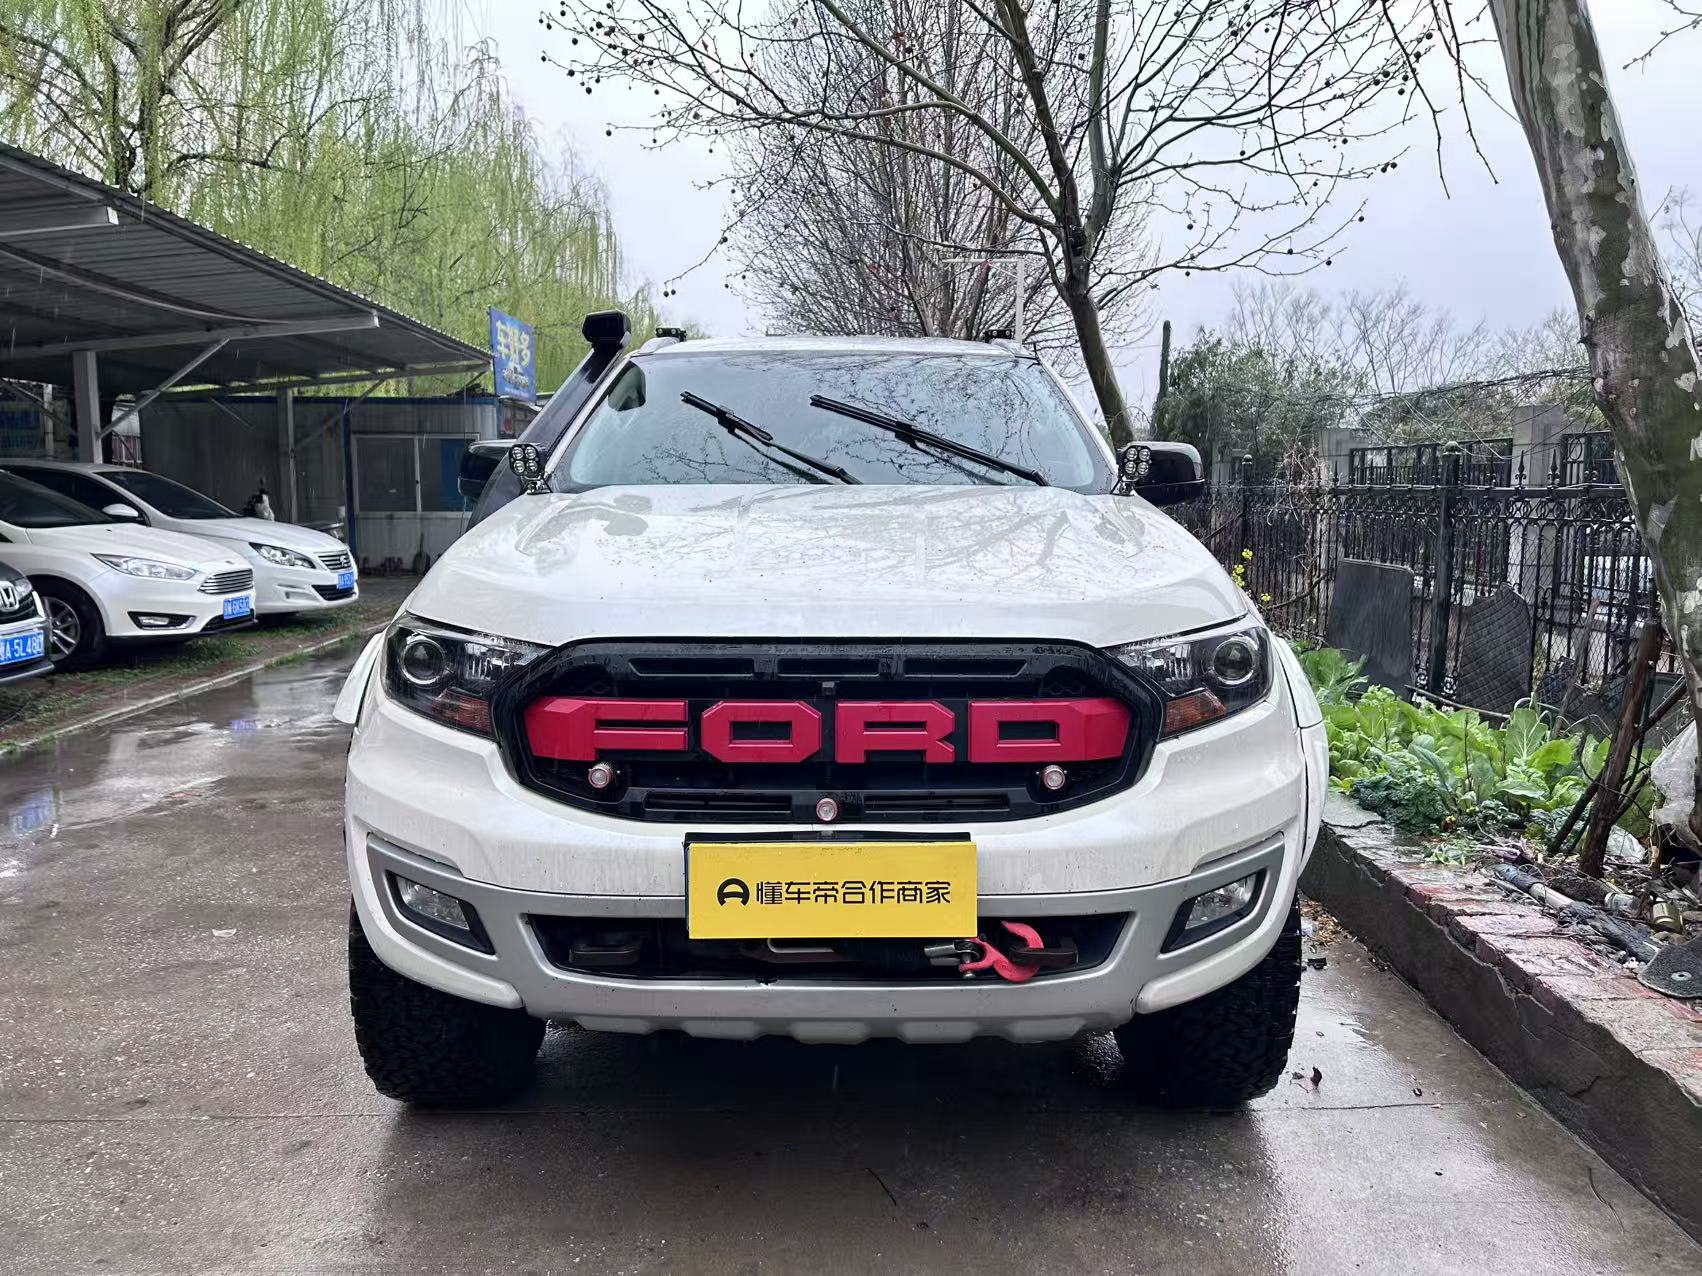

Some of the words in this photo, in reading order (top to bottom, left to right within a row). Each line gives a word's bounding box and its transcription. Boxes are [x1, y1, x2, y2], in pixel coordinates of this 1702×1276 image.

[523, 699, 1131, 763] FORD
[756, 880, 951, 905] 懂车帝合作商家
